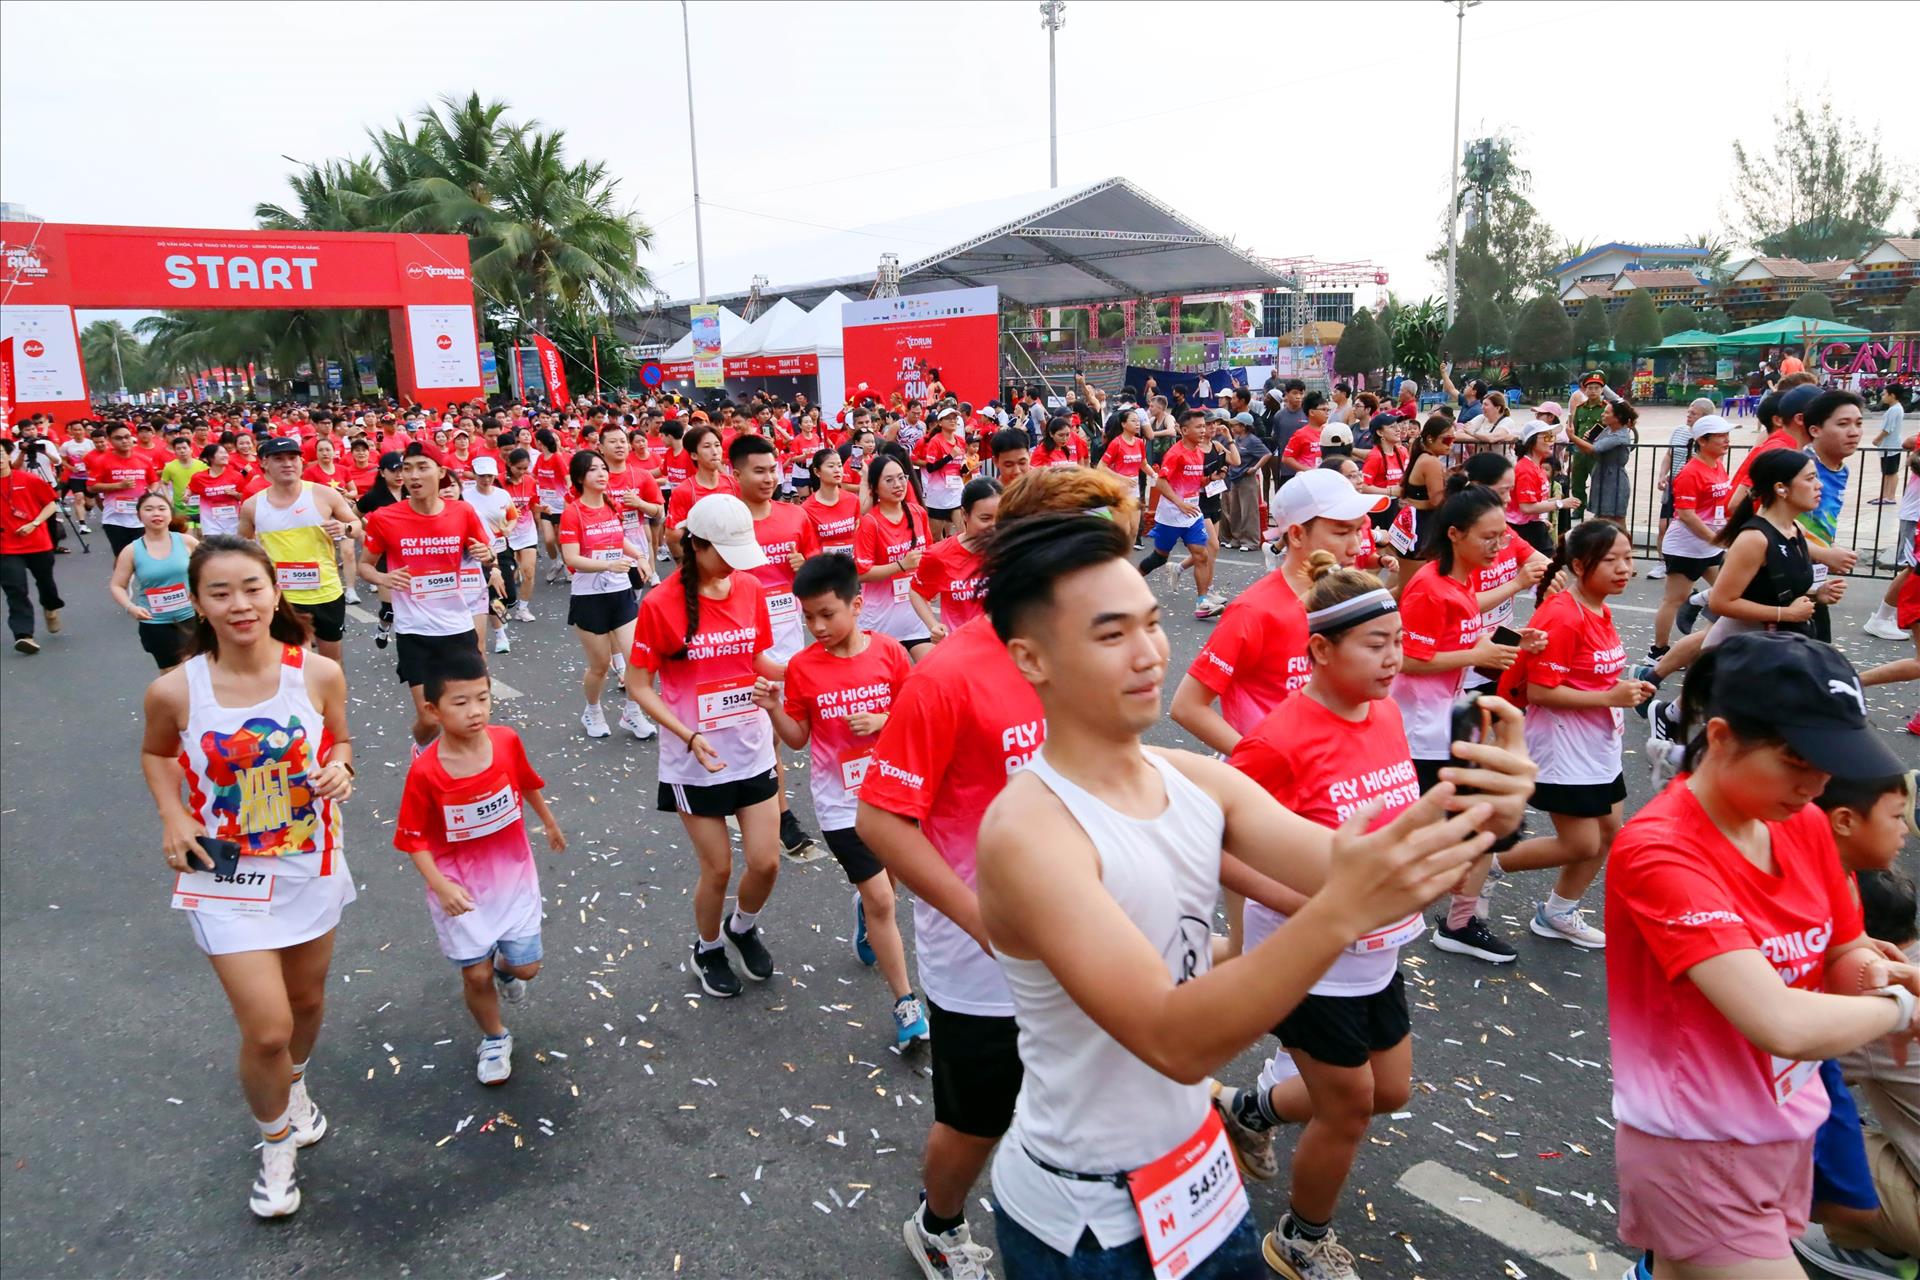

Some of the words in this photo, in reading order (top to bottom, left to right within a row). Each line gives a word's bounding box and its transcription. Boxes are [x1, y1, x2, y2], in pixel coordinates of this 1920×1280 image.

[7, 256, 41, 268] RUN
[164, 254, 318, 290] START
[423, 265, 465, 278] REDRUN
[906, 336, 933, 349] REDRUN
[902, 356, 917, 371] FLY
[1821, 339, 1920, 375] CAMI
[905, 381, 930, 399] RUN
[401, 537, 417, 547] FLY
[420, 535, 461, 545] HIGHER
[402, 546, 423, 556] RUN
[425, 545, 460, 555] FASTER
[887, 544, 901, 555] FLY
[292, 571, 317, 579] 50548
[428, 576, 455, 586] 50946
[951, 580, 969, 592] FLY
[770, 597, 793, 608] 51583
[952, 590, 974, 601] RUN
[687, 646, 715, 660] RUN
[716, 642, 755, 657] FASTE
[1287, 655, 1309, 674] FLY
[722, 691, 753, 706] 51347
[816, 691, 838, 707] FLY
[841, 682, 891, 703] HIGHER
[706, 704, 713, 713] F
[820, 703, 847, 720] RUN
[850, 695, 892, 714] FASTER
[1002, 720, 1038, 752] FLY
[851, 768, 861, 780] M
[879, 759, 925, 787] REDRUN
[1328, 777, 1360, 804] FLY
[1360, 759, 1416, 794] HIGHER
[476, 794, 509, 817] 51572
[453, 815, 465, 824] M
[213, 871, 266, 886] 54677
[1188, 1149, 1230, 1206] 54372
[1158, 1212, 1176, 1238] M
